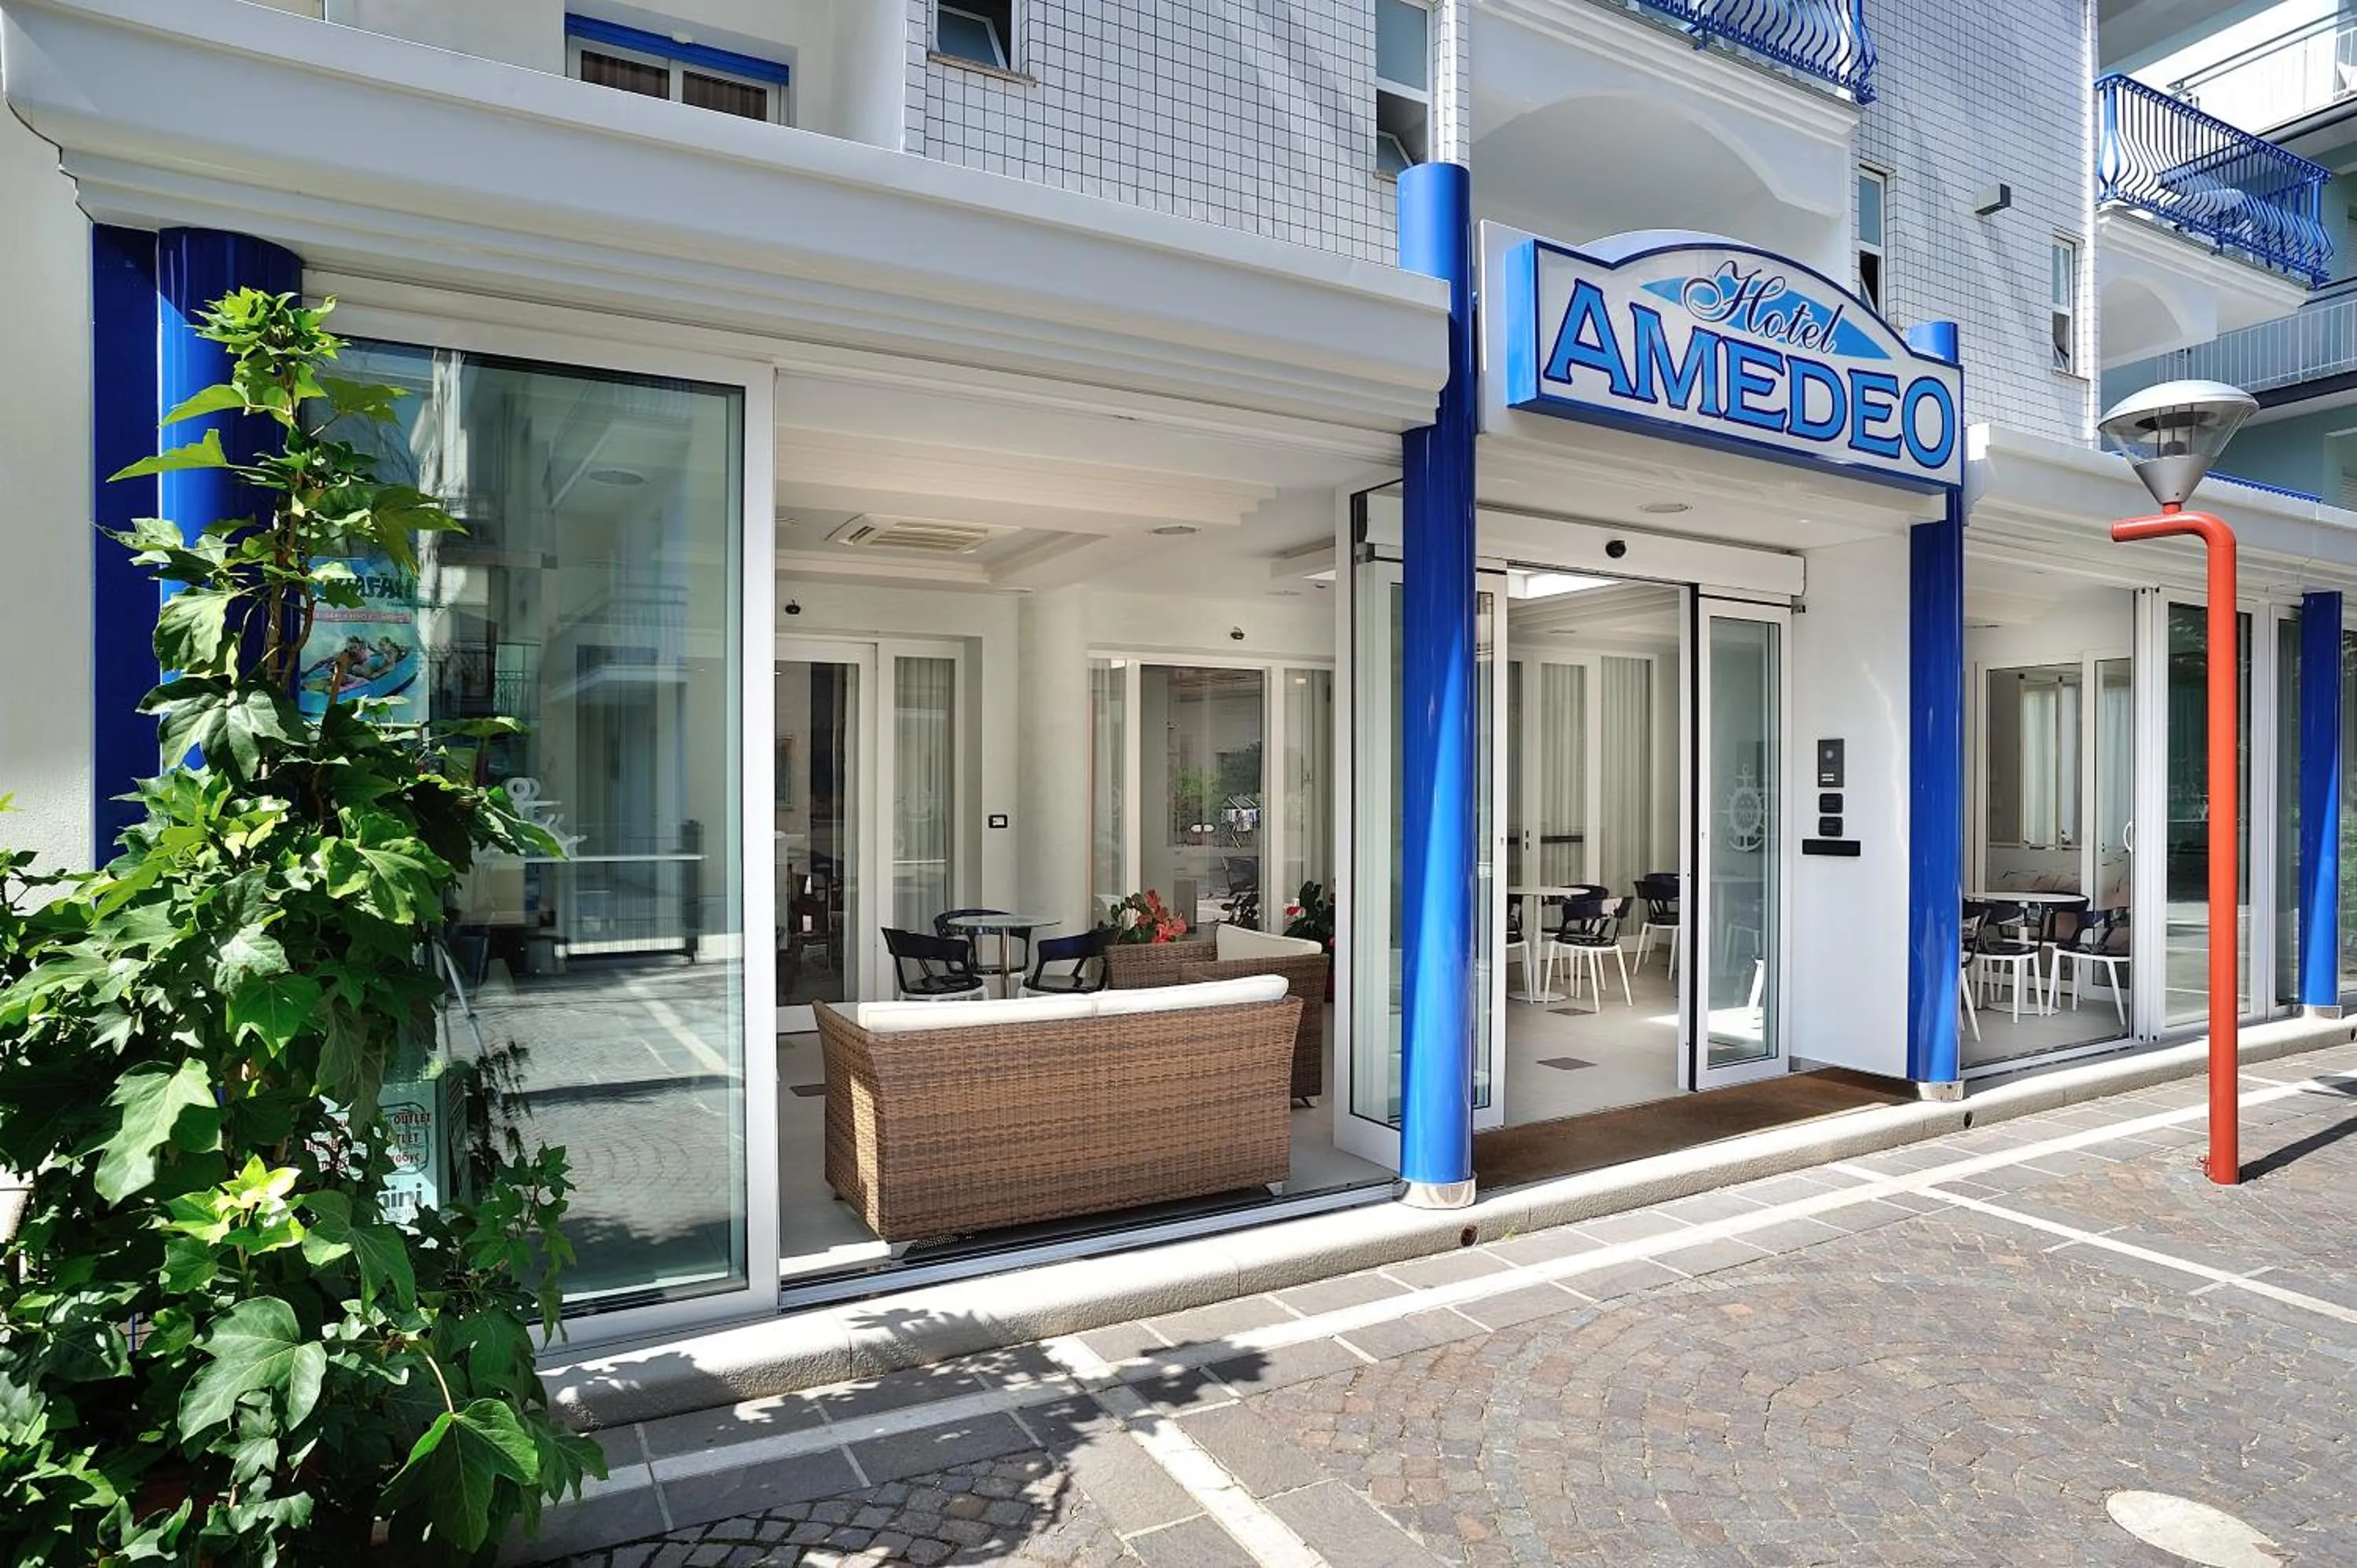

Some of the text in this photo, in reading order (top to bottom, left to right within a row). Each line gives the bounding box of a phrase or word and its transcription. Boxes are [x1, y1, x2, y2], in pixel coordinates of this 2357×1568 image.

[1681, 260, 1845, 355] Hotel
[1543, 277, 1956, 469] AMEDEO
[394, 1112, 431, 1125] OUTLET
